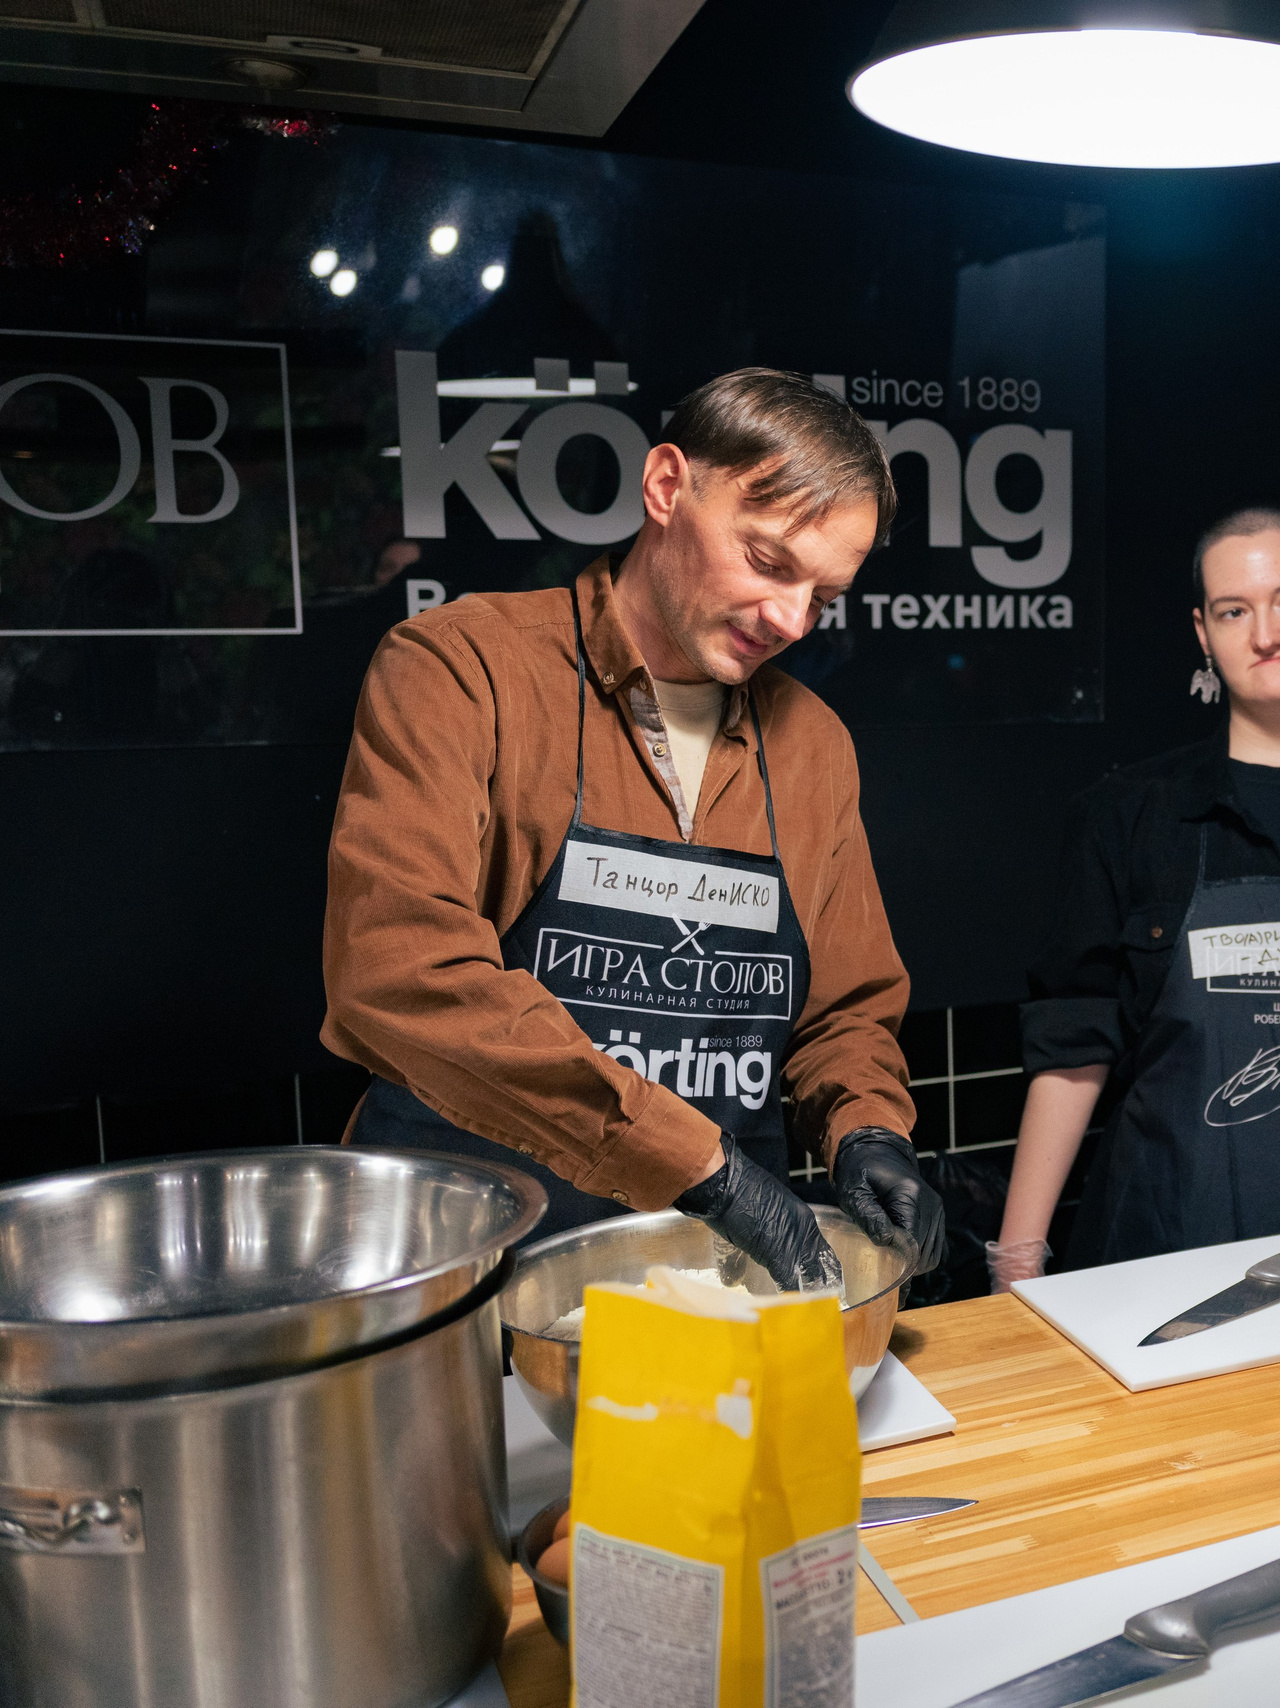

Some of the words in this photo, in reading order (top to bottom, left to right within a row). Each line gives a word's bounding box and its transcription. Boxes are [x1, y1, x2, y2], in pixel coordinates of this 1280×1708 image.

[851, 370, 944, 408] since
[957, 375, 1041, 413] 1889
[395, 350, 1074, 590] köng
[862, 593, 1074, 629] техника
[586, 856, 679, 902] Танцор
[547, 937, 651, 988] ИГРА
[660, 957, 786, 996] СТОЛОВ
[585, 985, 698, 1008] КУЛИНАРНАЯ
[706, 997, 750, 1010] СТУДИЯ
[708, 1036, 733, 1048] since
[735, 1034, 764, 1047] 1889
[592, 1029, 772, 1110] örting
